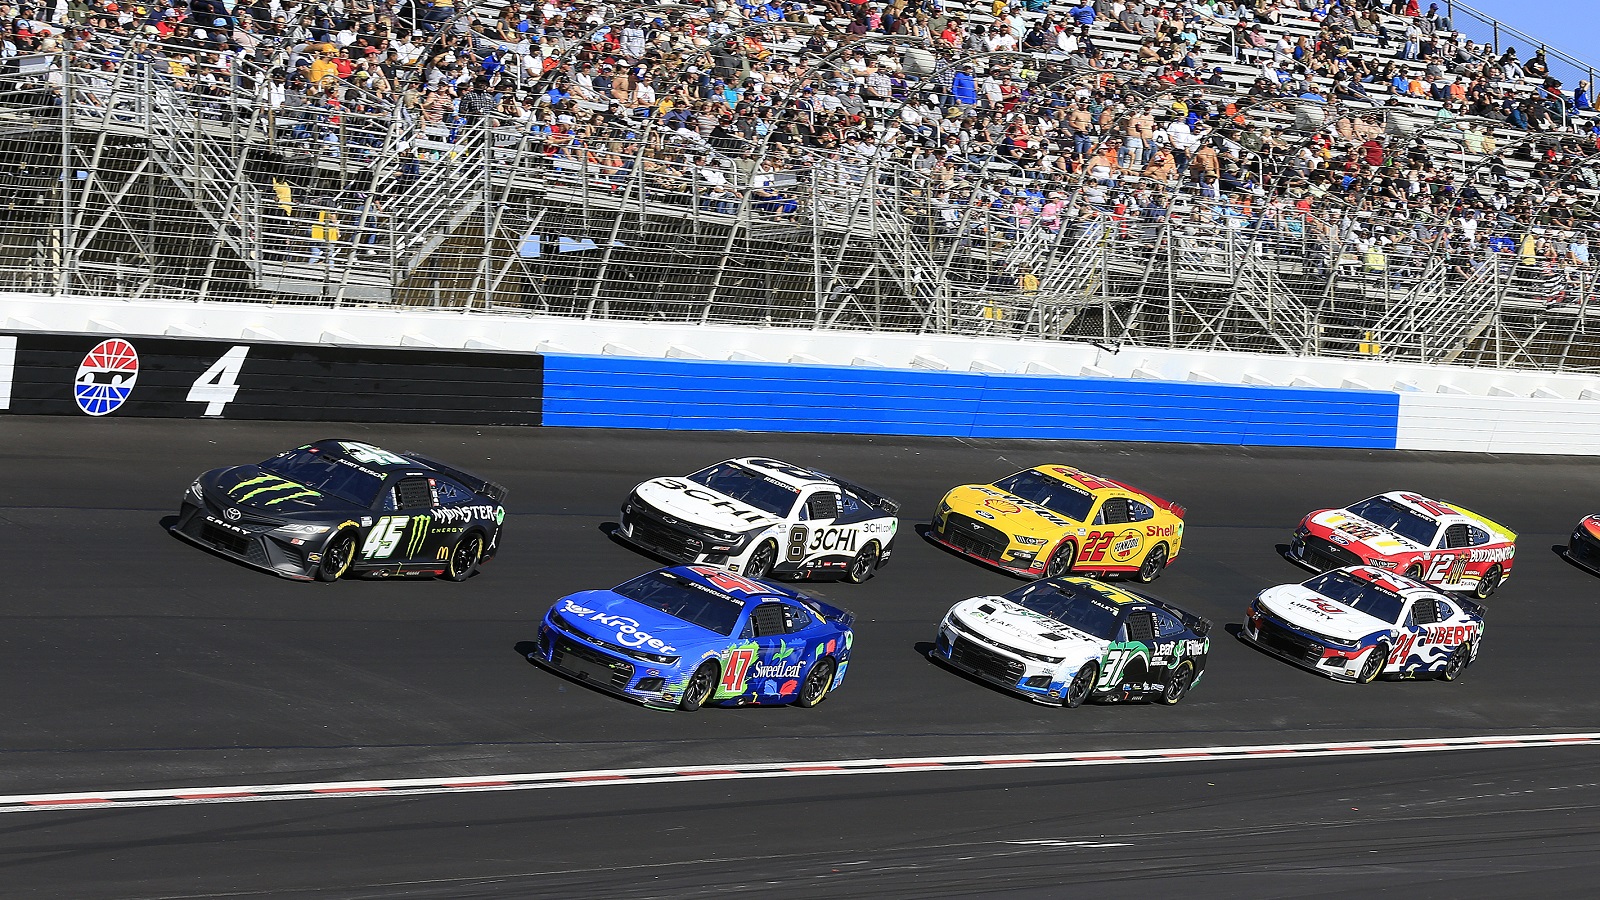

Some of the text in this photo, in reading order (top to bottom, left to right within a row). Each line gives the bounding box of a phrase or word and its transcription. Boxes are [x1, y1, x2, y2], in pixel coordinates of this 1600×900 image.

[186, 346, 250, 415] 4
[339, 458, 383, 479] KURT BUSCH
[763, 476, 797, 493] REDDICK
[1062, 482, 1089, 496] LOGANO
[650, 478, 769, 524] 3CHI
[430, 505, 495, 524] MONSTER
[1409, 510, 1435, 522] BLANEY
[206, 515, 252, 534] CAMRY
[1146, 524, 1174, 537] Shell
[361, 515, 410, 560] 45
[785, 524, 809, 562] 8
[809, 528, 857, 552] 3CHI
[1077, 531, 1115, 562] 22
[1114, 538, 1139, 552] PENNZOIL
[1423, 554, 1455, 581] 12
[689, 582, 730, 600] STENHOUSE
[1374, 586, 1398, 598] BYRON
[1091, 600, 1114, 612] HALEY
[1290, 601, 1334, 620] LIBERTY
[589, 612, 677, 654] Kroger
[1425, 625, 1477, 644] LIBERTY
[1153, 641, 1175, 656] Leaf
[1388, 634, 1417, 664] 24
[721, 649, 755, 692] 47
[753, 660, 802, 678] SweetLeaf
[1098, 650, 1131, 686] 31
